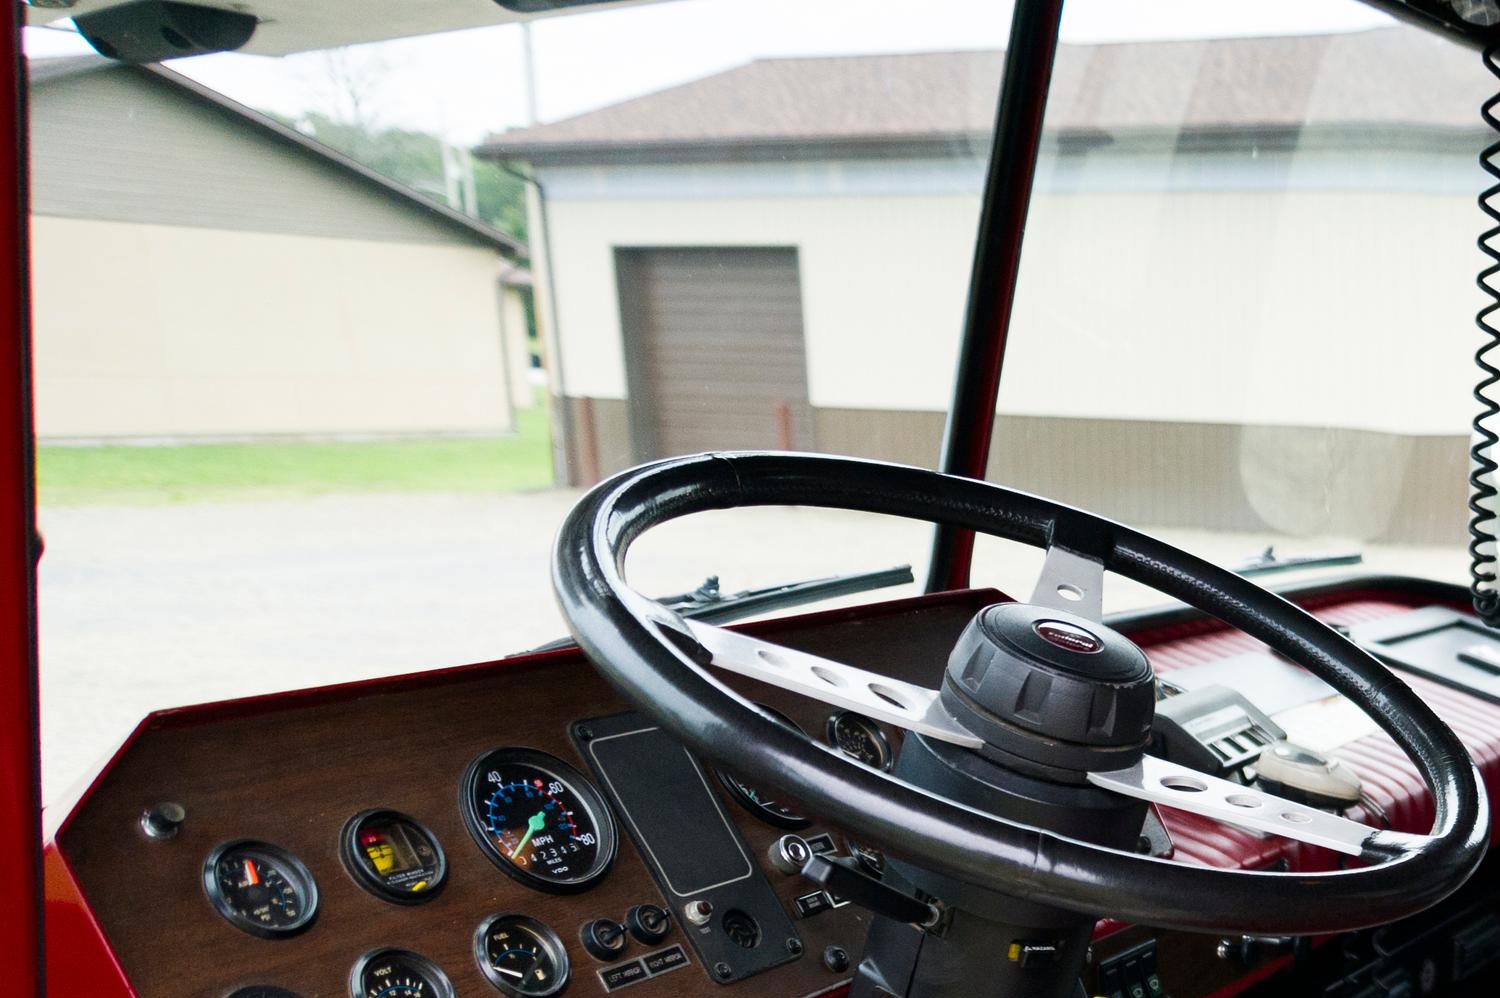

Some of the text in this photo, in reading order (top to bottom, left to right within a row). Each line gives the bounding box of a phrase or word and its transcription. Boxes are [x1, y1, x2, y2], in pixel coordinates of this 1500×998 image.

[487, 770, 502, 784] 40
[548, 780, 565, 795] 60
[531, 834, 554, 848] MPH
[580, 832, 596, 846] 80
[373, 966, 393, 977] VOLT
